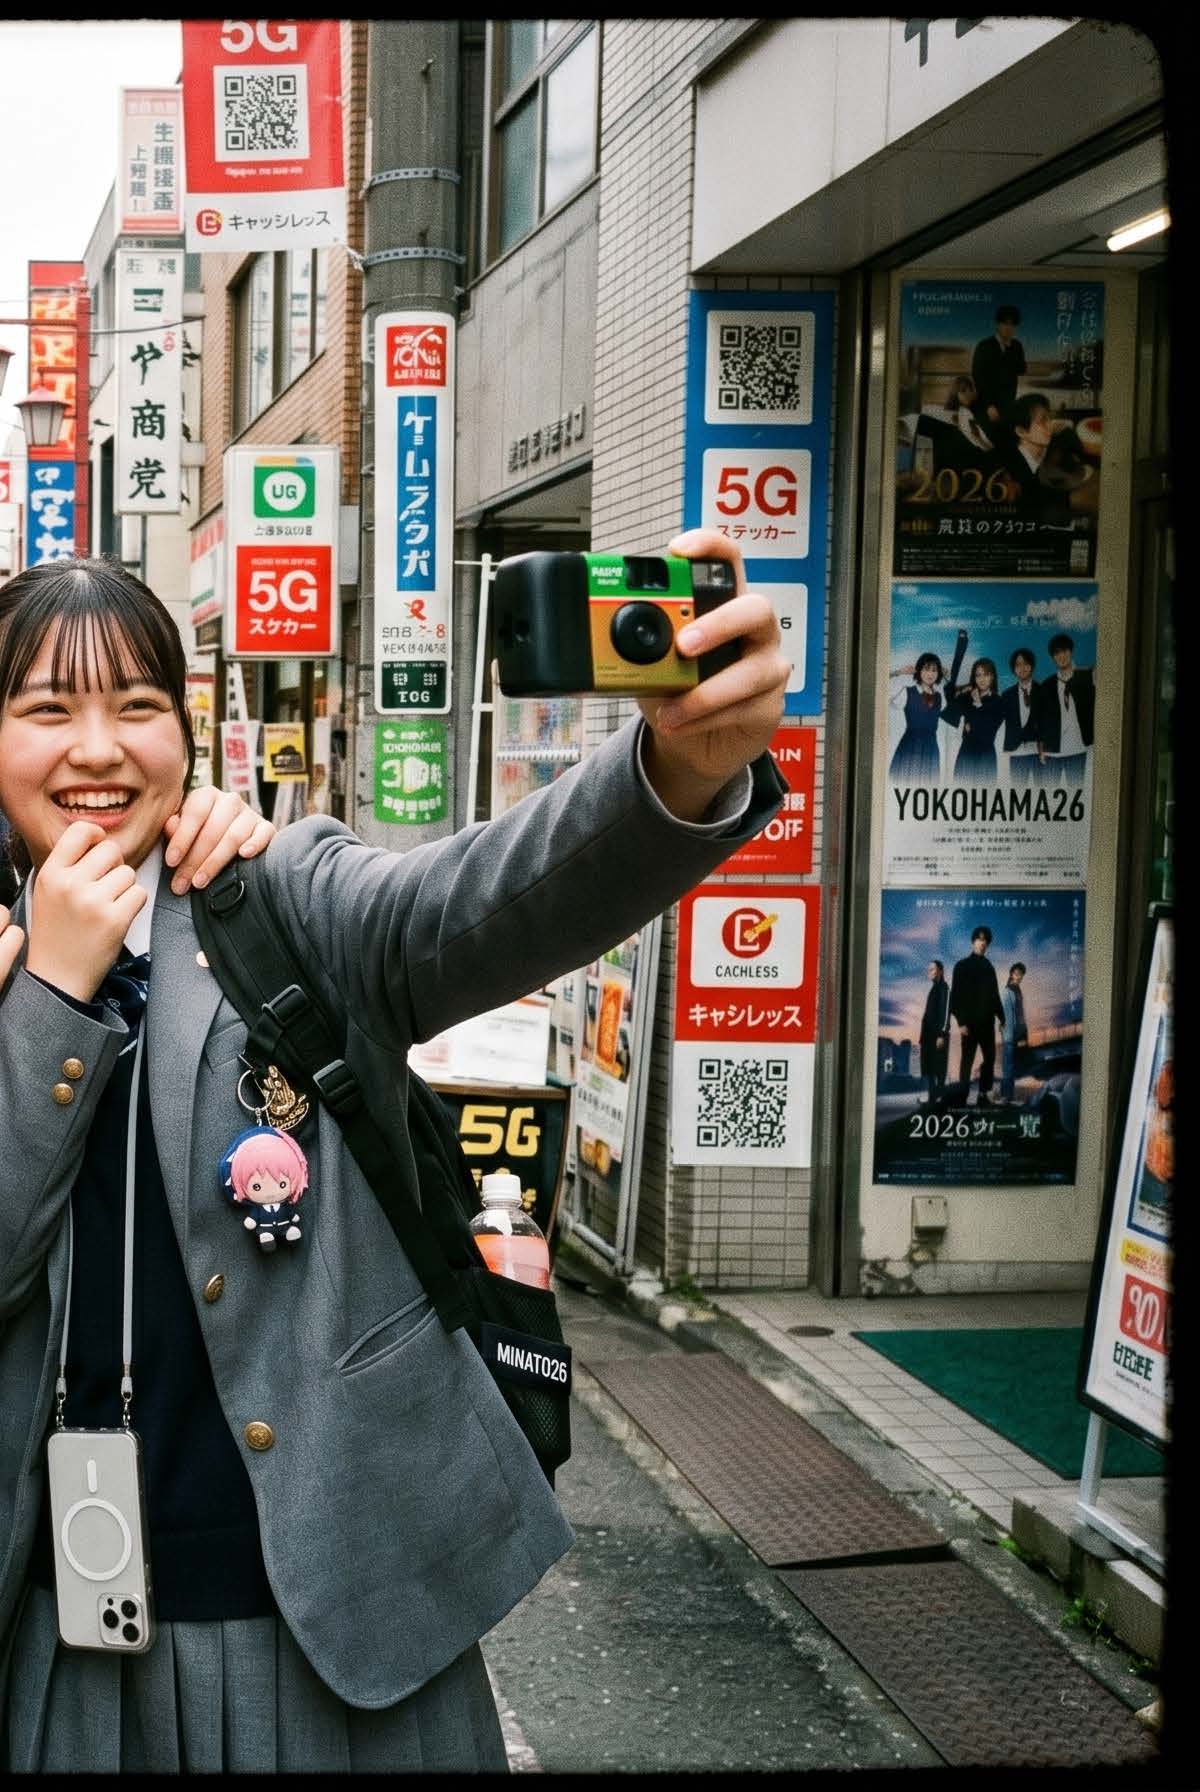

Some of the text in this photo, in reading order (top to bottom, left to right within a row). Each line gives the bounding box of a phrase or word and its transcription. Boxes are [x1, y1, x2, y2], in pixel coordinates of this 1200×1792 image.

[220, 19, 298, 53] 5G
[272, 484, 298, 500] UG
[716, 466, 797, 516] 5G
[910, 467, 1008, 503] 2026
[717, 524, 797, 541] ステッカー
[248, 569, 318, 613] 5G
[894, 788, 1085, 822] YOKOHAMA26
[715, 965, 779, 979] CACHLESS
[688, 1003, 803, 1028] キャシレッス
[460, 1104, 541, 1157] 5G
[909, 1114, 969, 1139] 2026
[497, 1342, 568, 1384] MINATO26
